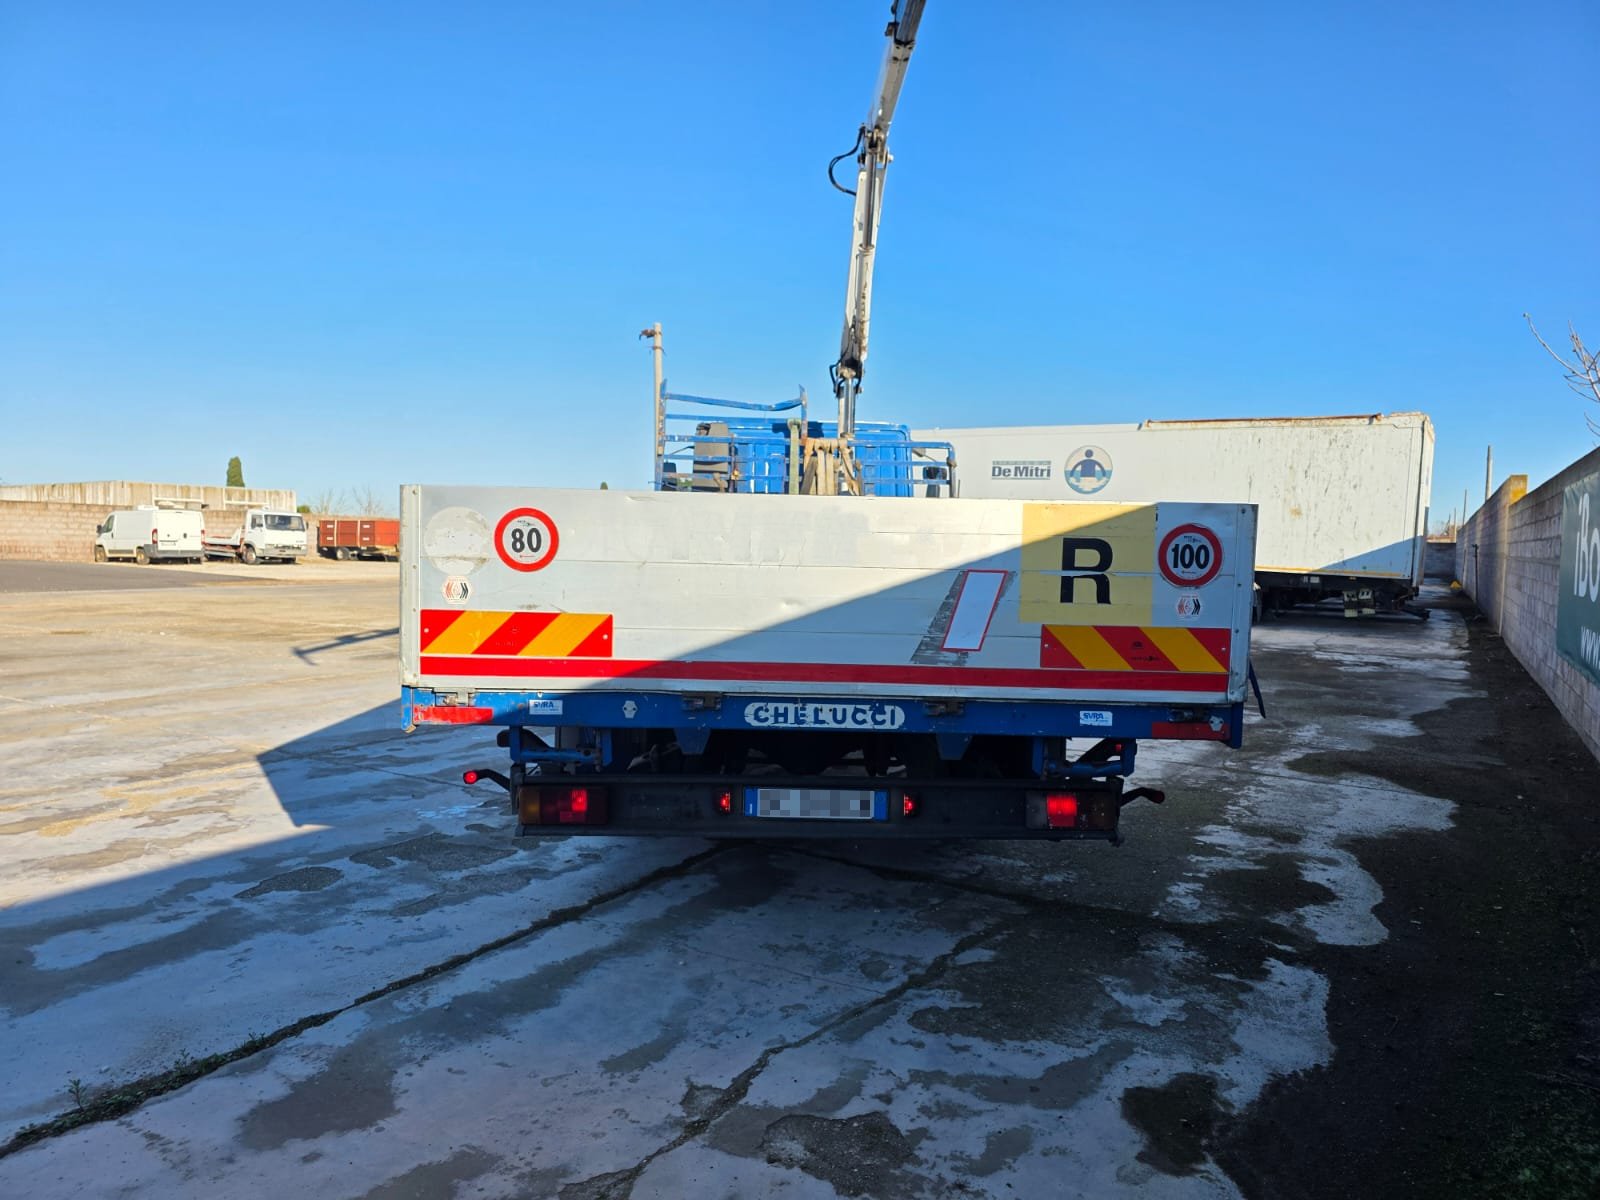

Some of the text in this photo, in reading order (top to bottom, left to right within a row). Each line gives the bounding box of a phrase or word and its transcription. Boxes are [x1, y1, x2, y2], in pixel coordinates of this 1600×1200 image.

[991, 466, 1051, 477] De Mitri
[511, 527, 542, 553] 80
[1171, 543, 1210, 570] 100
[1060, 537, 1113, 605] R
[753, 705, 896, 726] CHELUCCI
